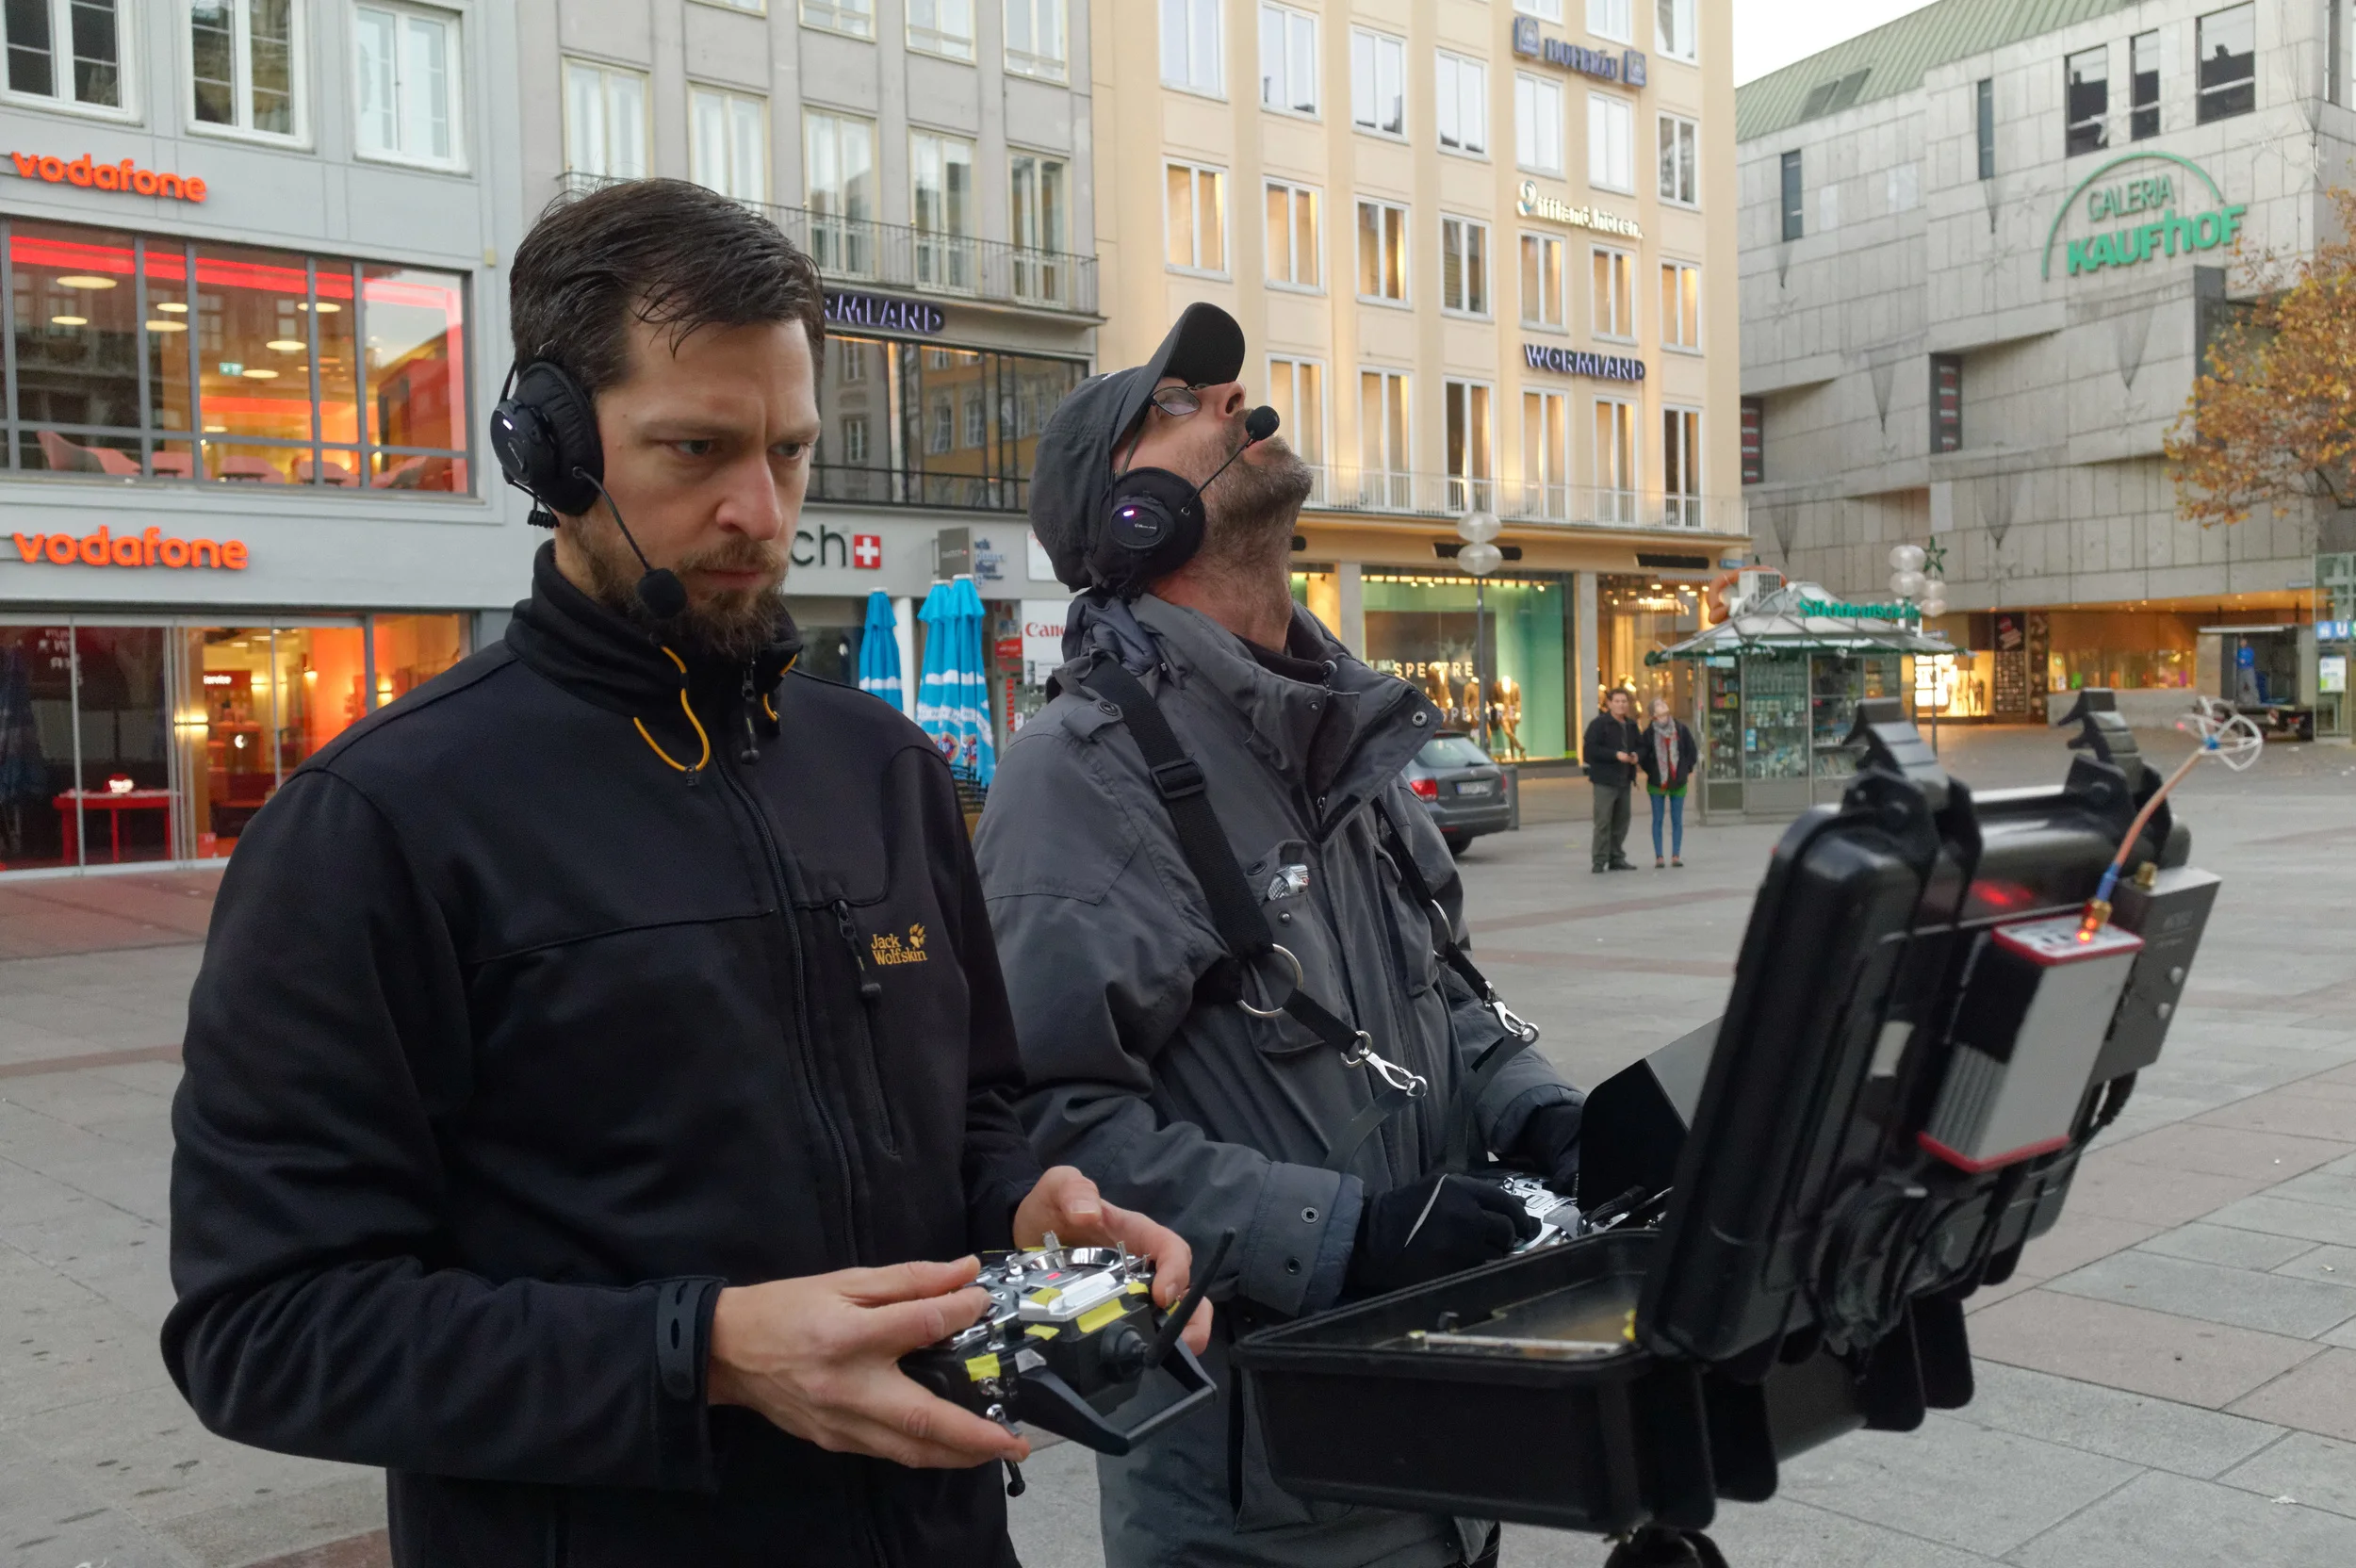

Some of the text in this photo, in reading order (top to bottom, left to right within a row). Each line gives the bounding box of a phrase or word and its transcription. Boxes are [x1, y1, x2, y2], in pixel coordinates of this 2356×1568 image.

[11, 151, 207, 204] vodafone
[2086, 173, 2176, 222] GALERIA
[1524, 343, 1646, 382] WORMLAND
[11, 524, 250, 571] vodafone
[871, 933, 902, 950] Jack
[872, 946, 928, 966] Wolfskin
